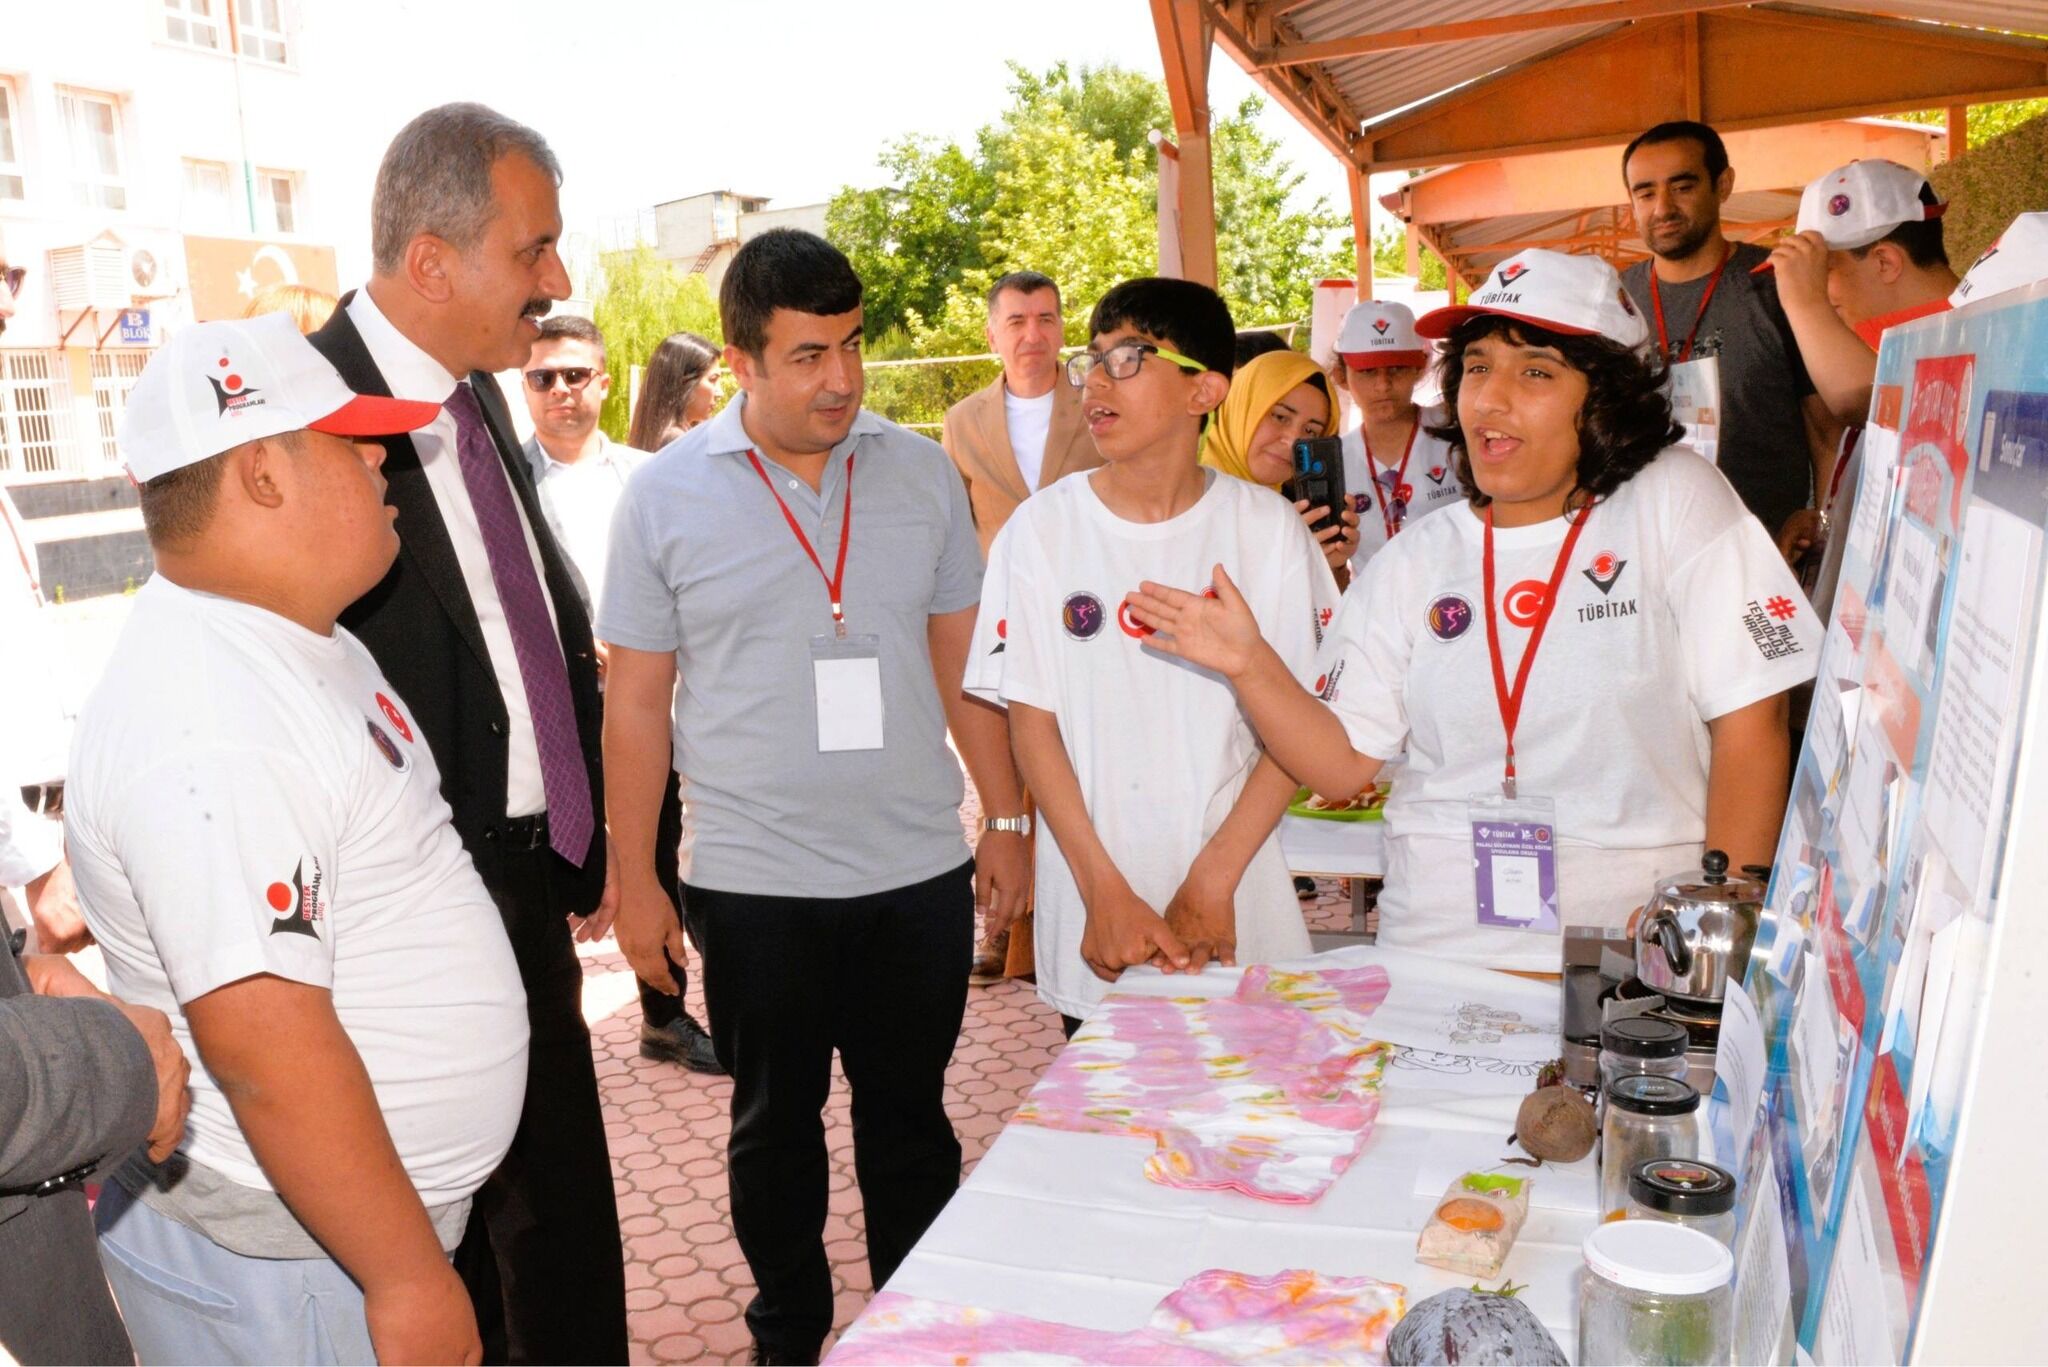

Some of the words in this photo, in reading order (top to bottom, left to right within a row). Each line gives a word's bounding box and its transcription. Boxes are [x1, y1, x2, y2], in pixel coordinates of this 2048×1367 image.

[1480, 291, 1521, 305] TÜBİTAK
[121, 327, 150, 339] BLOK
[1427, 485, 1457, 500] TÜBİTAK
[1577, 599, 1637, 623] TÜBİTAK
[1492, 829, 1515, 839] TÜBİTAK
[303, 885, 311, 920] DESTEK
